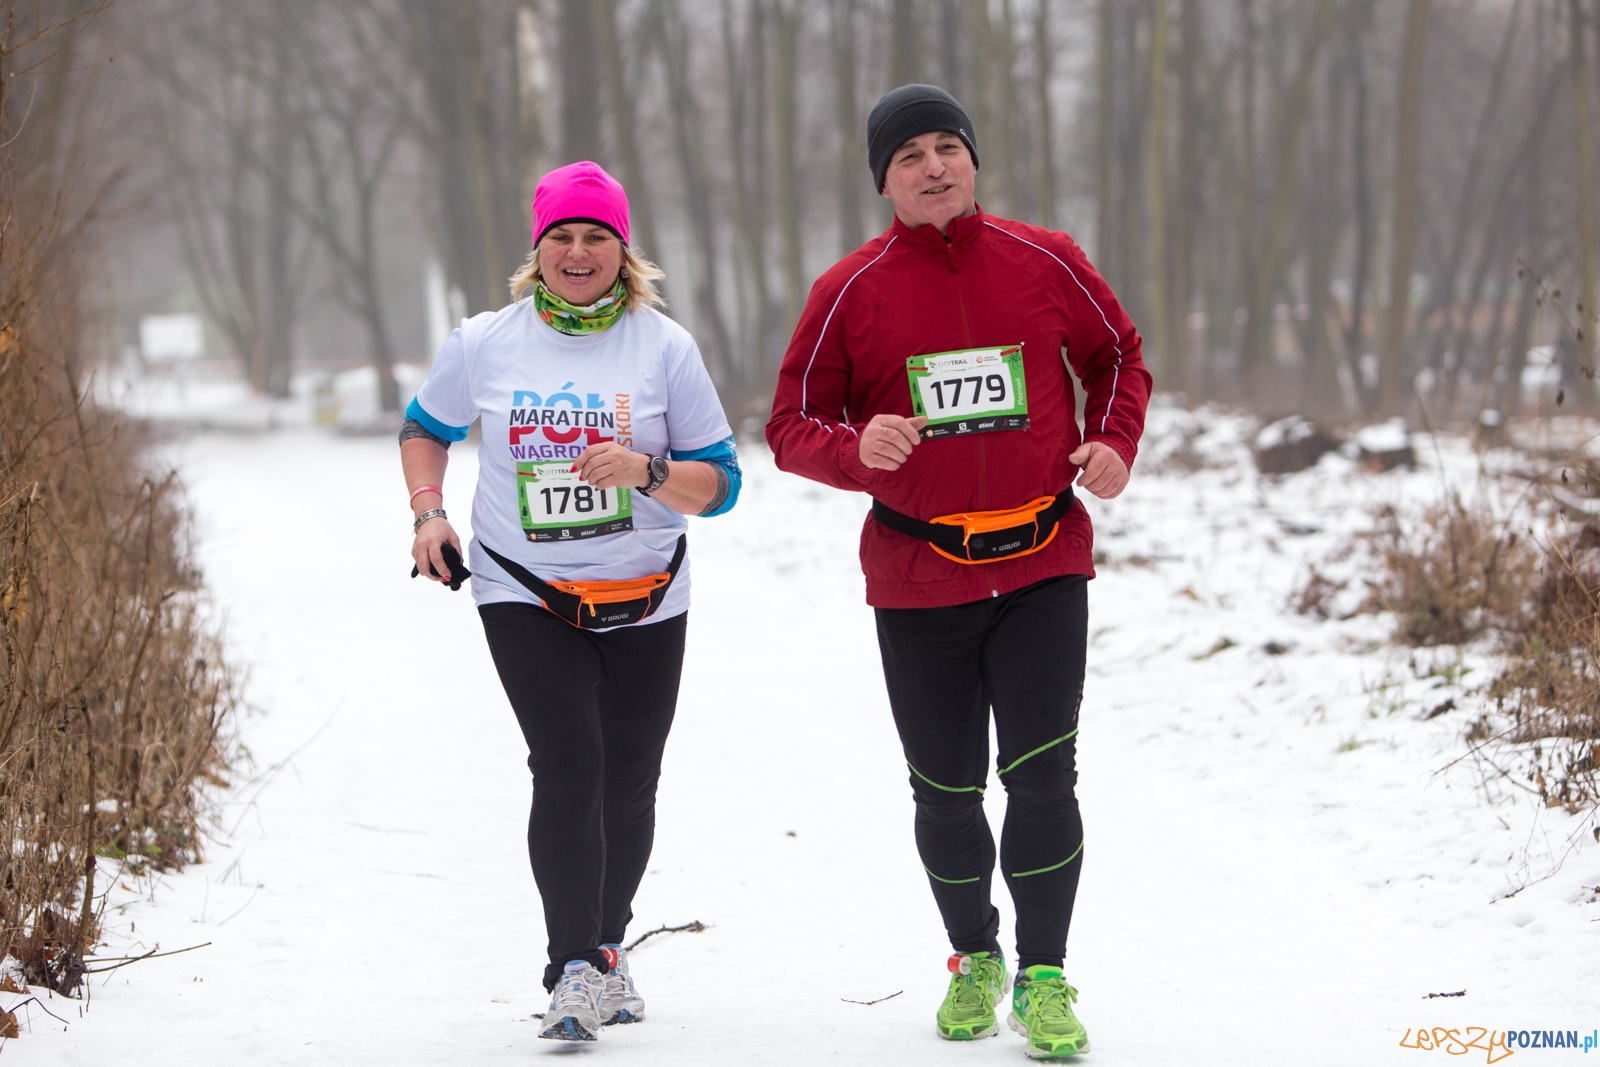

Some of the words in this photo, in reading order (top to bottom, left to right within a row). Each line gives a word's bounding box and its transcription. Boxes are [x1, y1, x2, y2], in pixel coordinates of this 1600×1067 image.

[930, 374, 1006, 409] 1779
[509, 408, 615, 428] MARATON
[615, 393, 633, 447] SKOKI
[540, 486, 607, 515] 1781
[608, 613, 628, 621] BRUGI
